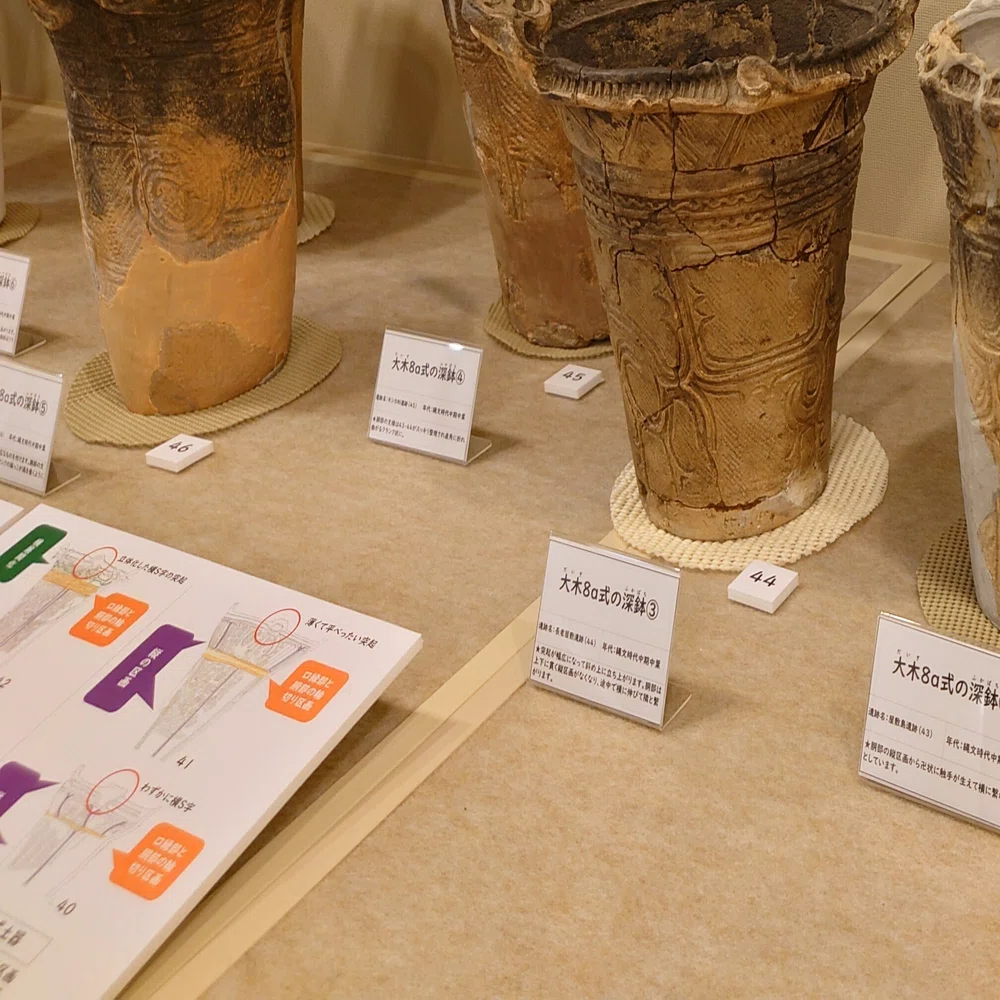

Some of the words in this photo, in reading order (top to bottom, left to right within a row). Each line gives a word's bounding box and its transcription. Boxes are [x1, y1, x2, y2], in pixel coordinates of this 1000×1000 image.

[562, 370, 585, 382] 45
[168, 440, 193, 453] 46
[749, 570, 776, 587] 44
[559, 573, 659, 620] 大木8a式の深鉢③
[176, 756, 194, 769] 41
[862, 752, 899, 774] としています。
[57, 898, 77, 916] 40
